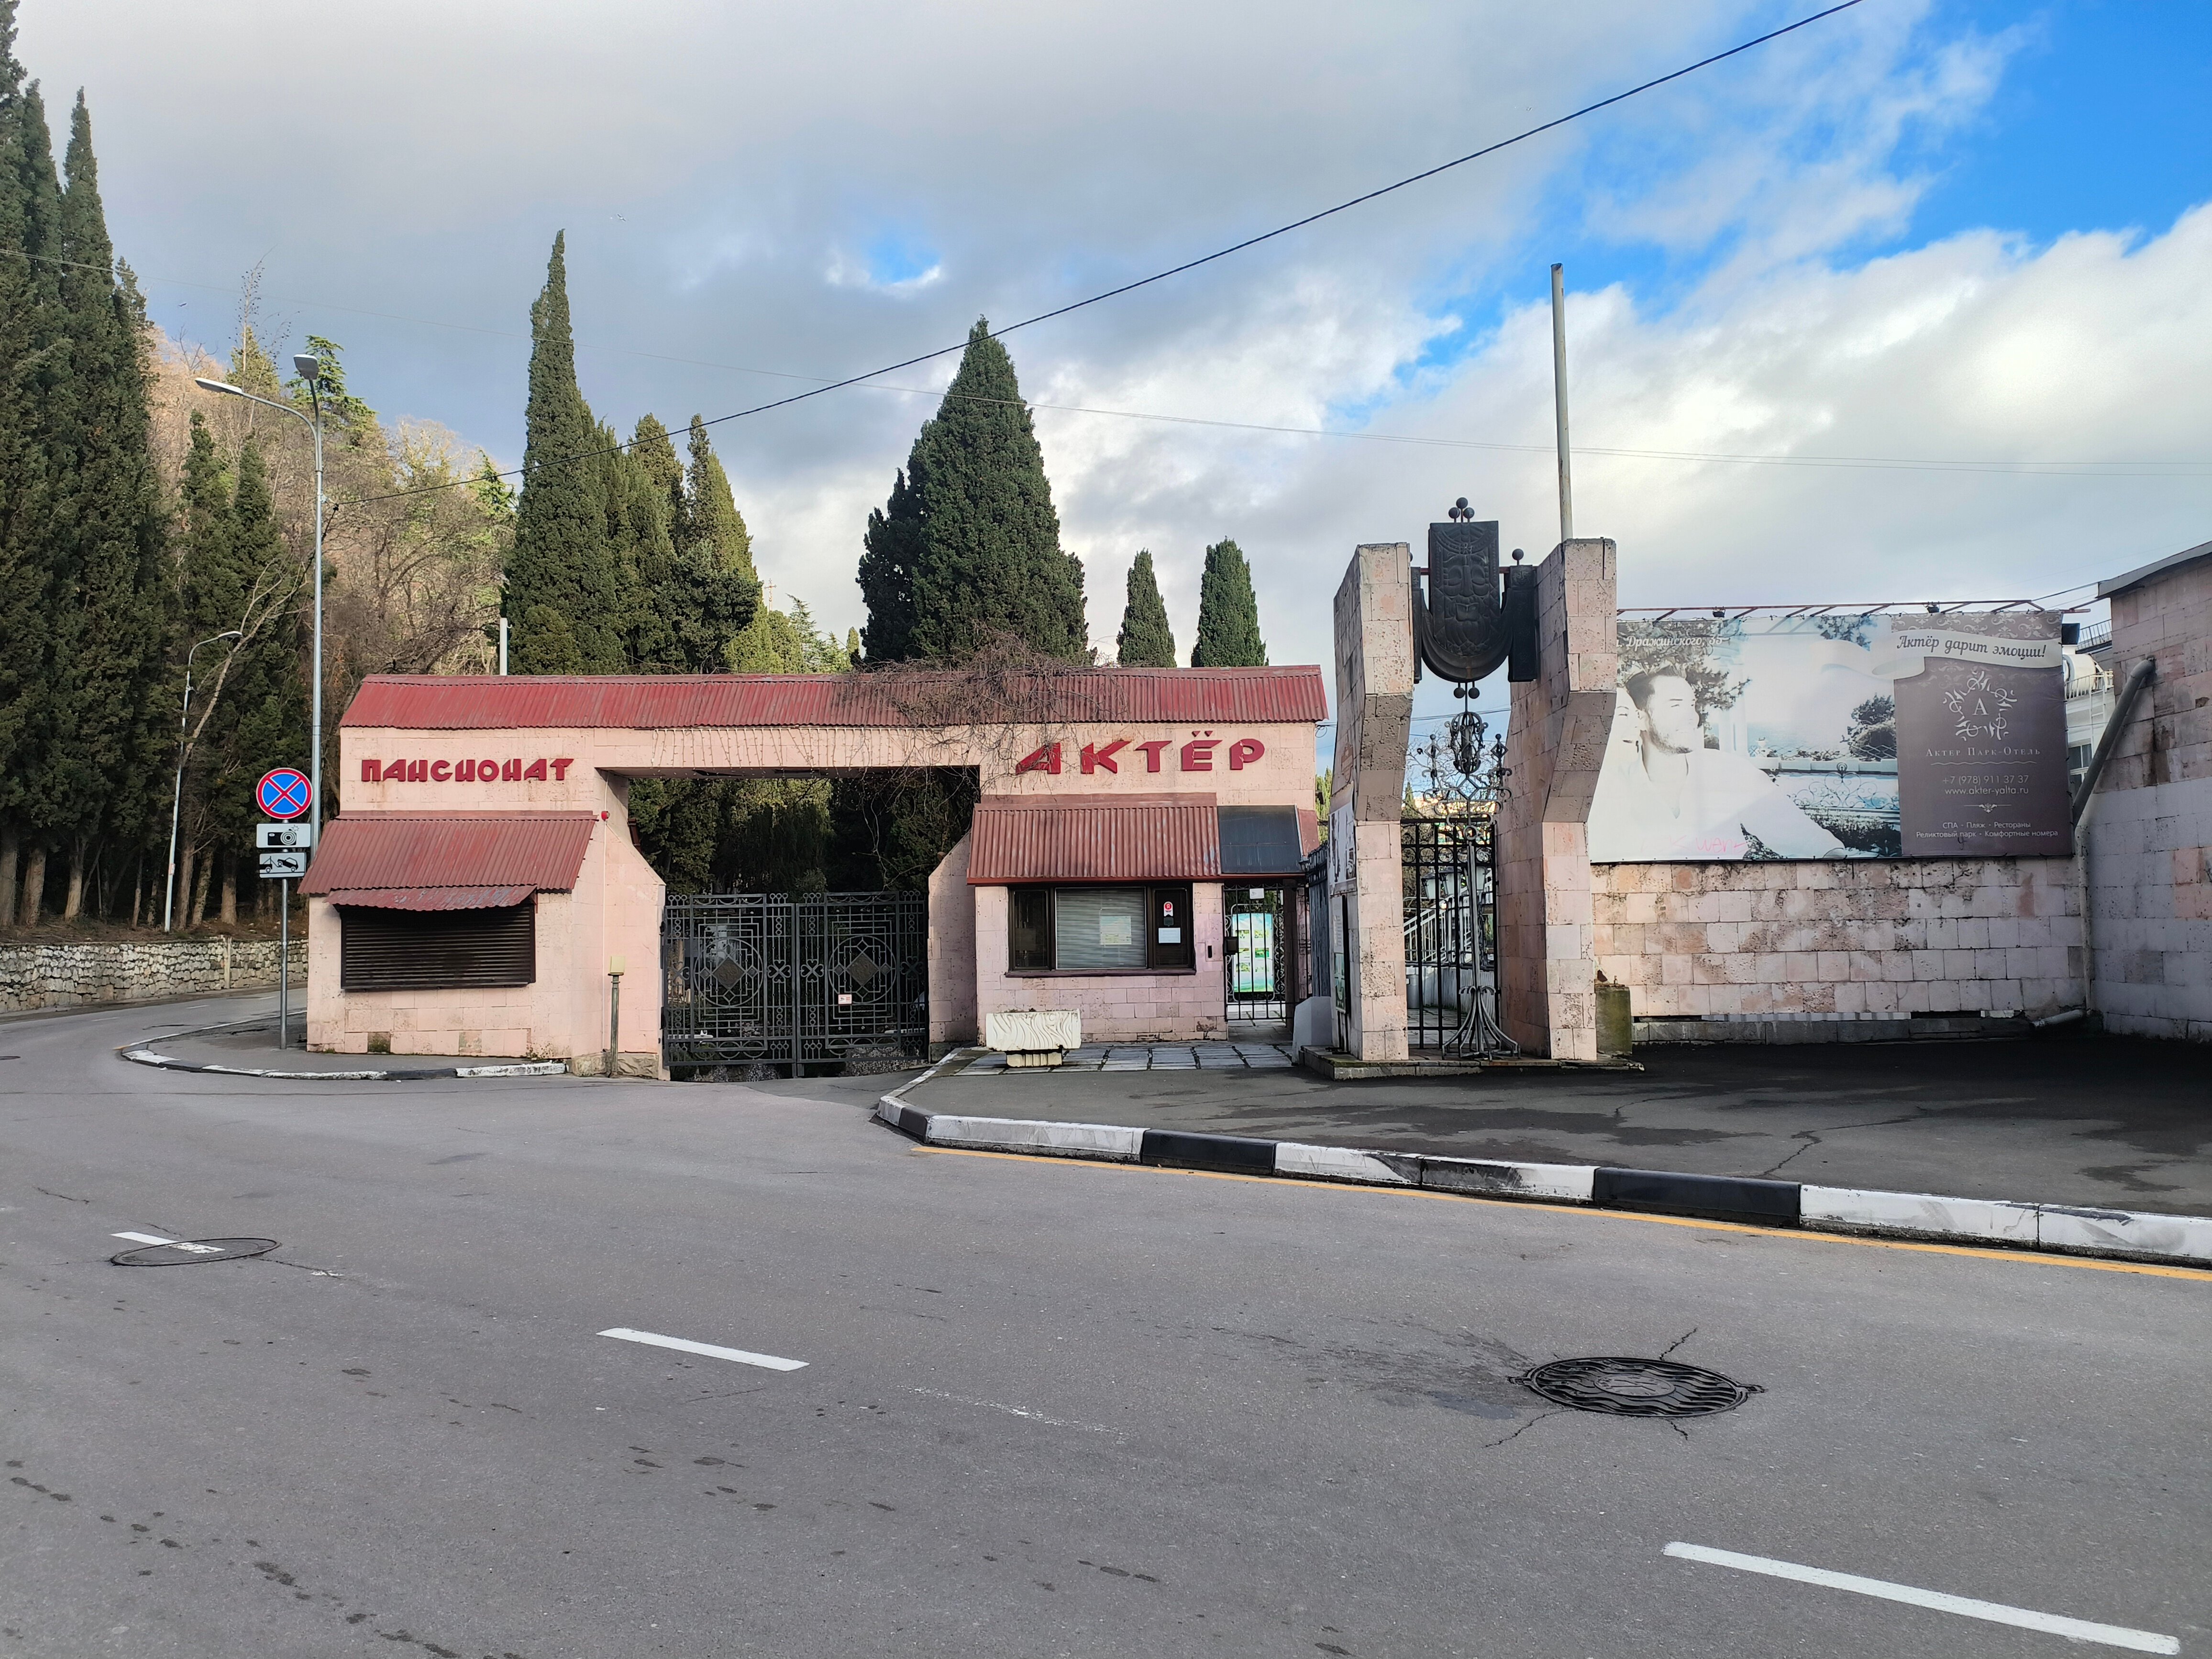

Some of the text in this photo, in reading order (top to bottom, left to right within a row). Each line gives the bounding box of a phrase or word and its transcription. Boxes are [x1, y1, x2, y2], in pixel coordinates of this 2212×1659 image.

[1626, 635, 1705, 652] Дражинского,
[1709, 634, 1723, 646] 35
[1897, 635, 2046, 660] Актёр дарит эмоции!
[1015, 730, 1265, 775] АКТЁР
[361, 758, 574, 782] ПАНСИОНАТ
[1943, 775, 2029, 785] +7 (978) 911 37 37
[1945, 785, 2029, 796] www.akter-yalta.ru
[1994, 821, 2031, 830] Рестораны
[1985, 830, 2030, 838] Комфортные
